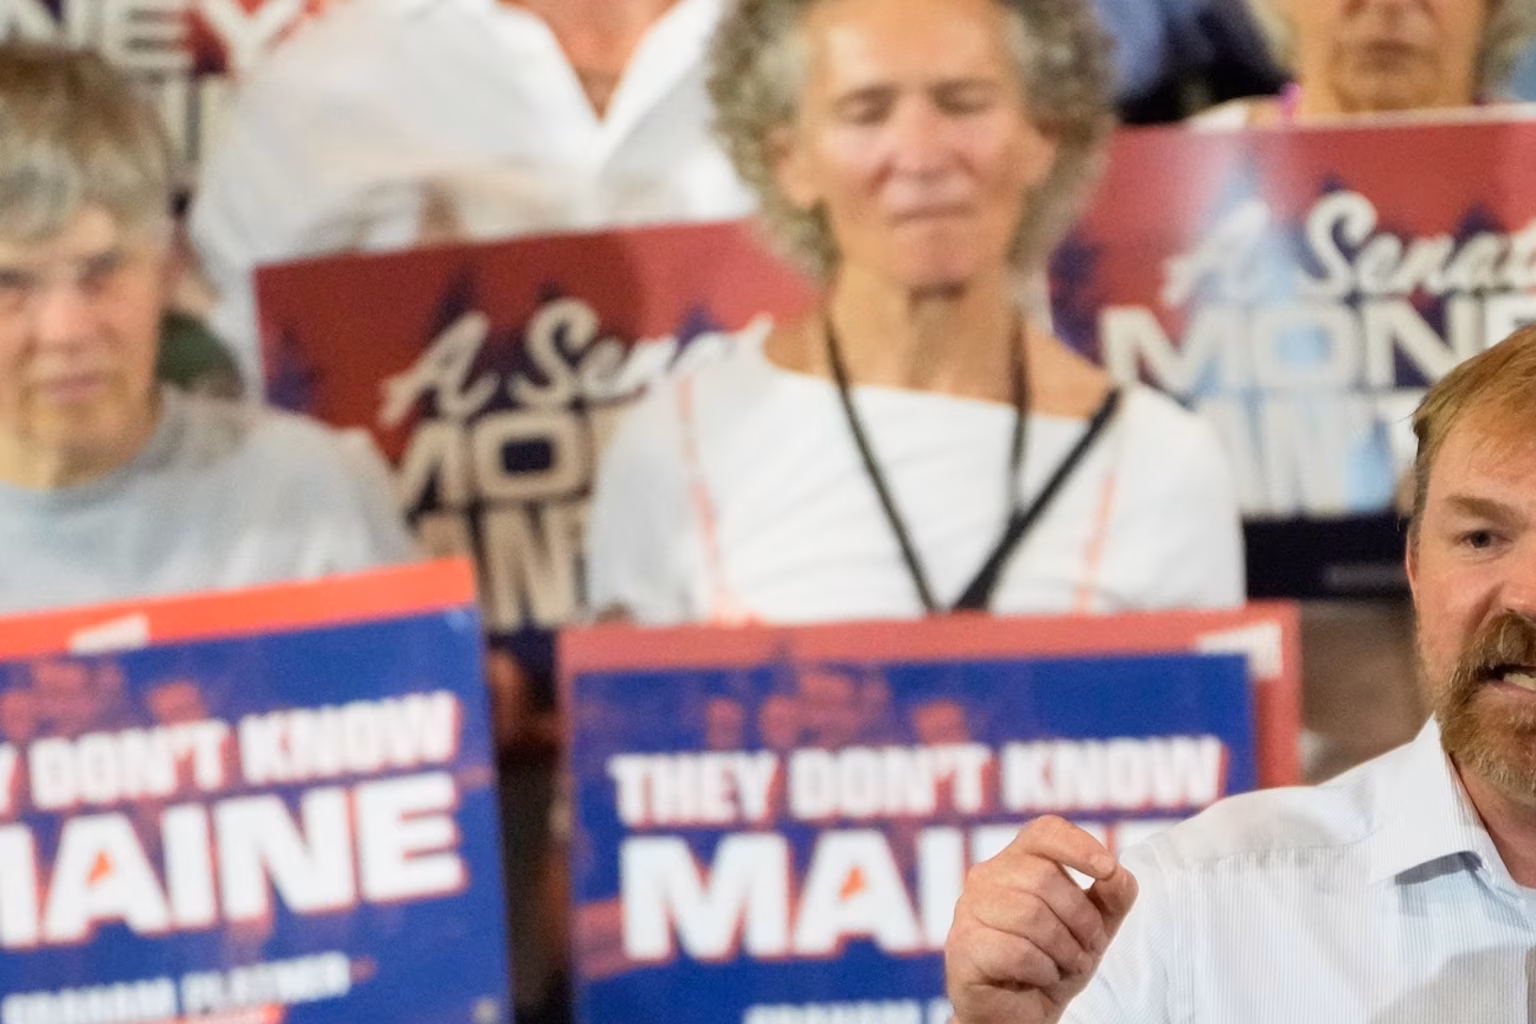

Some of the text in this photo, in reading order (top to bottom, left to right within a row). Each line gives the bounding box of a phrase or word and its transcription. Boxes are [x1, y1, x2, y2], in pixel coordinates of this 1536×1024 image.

[28, 718, 229, 811] DON'T
[238, 688, 458, 785] KNOW
[609, 734, 1220, 821] THEY DON'T KNOW
